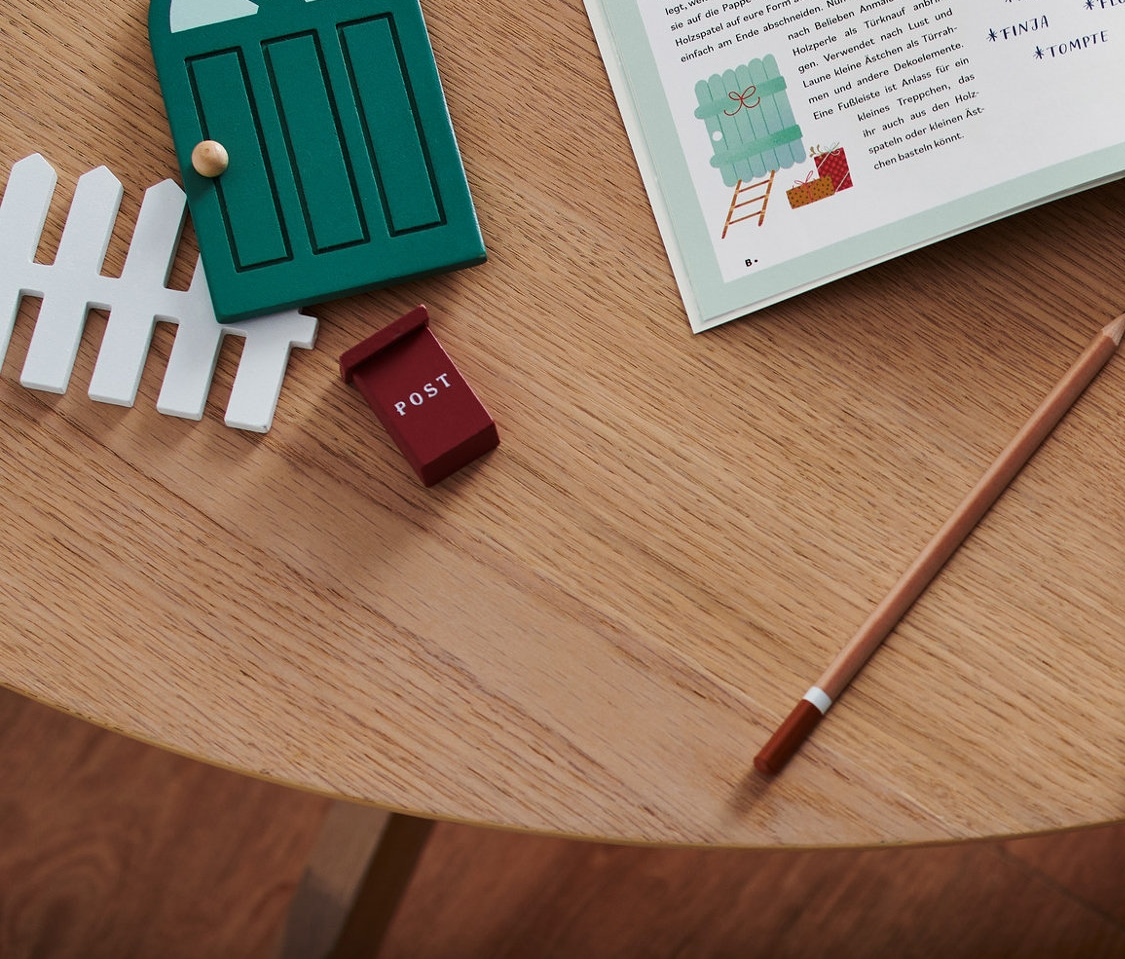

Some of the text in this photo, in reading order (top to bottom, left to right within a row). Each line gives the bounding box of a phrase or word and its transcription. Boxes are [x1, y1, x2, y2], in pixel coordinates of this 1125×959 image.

[1000, 15, 1050, 41] FINJA
[1047, 30, 1109, 58] TOMPTE
[394, 373, 451, 416] POST
